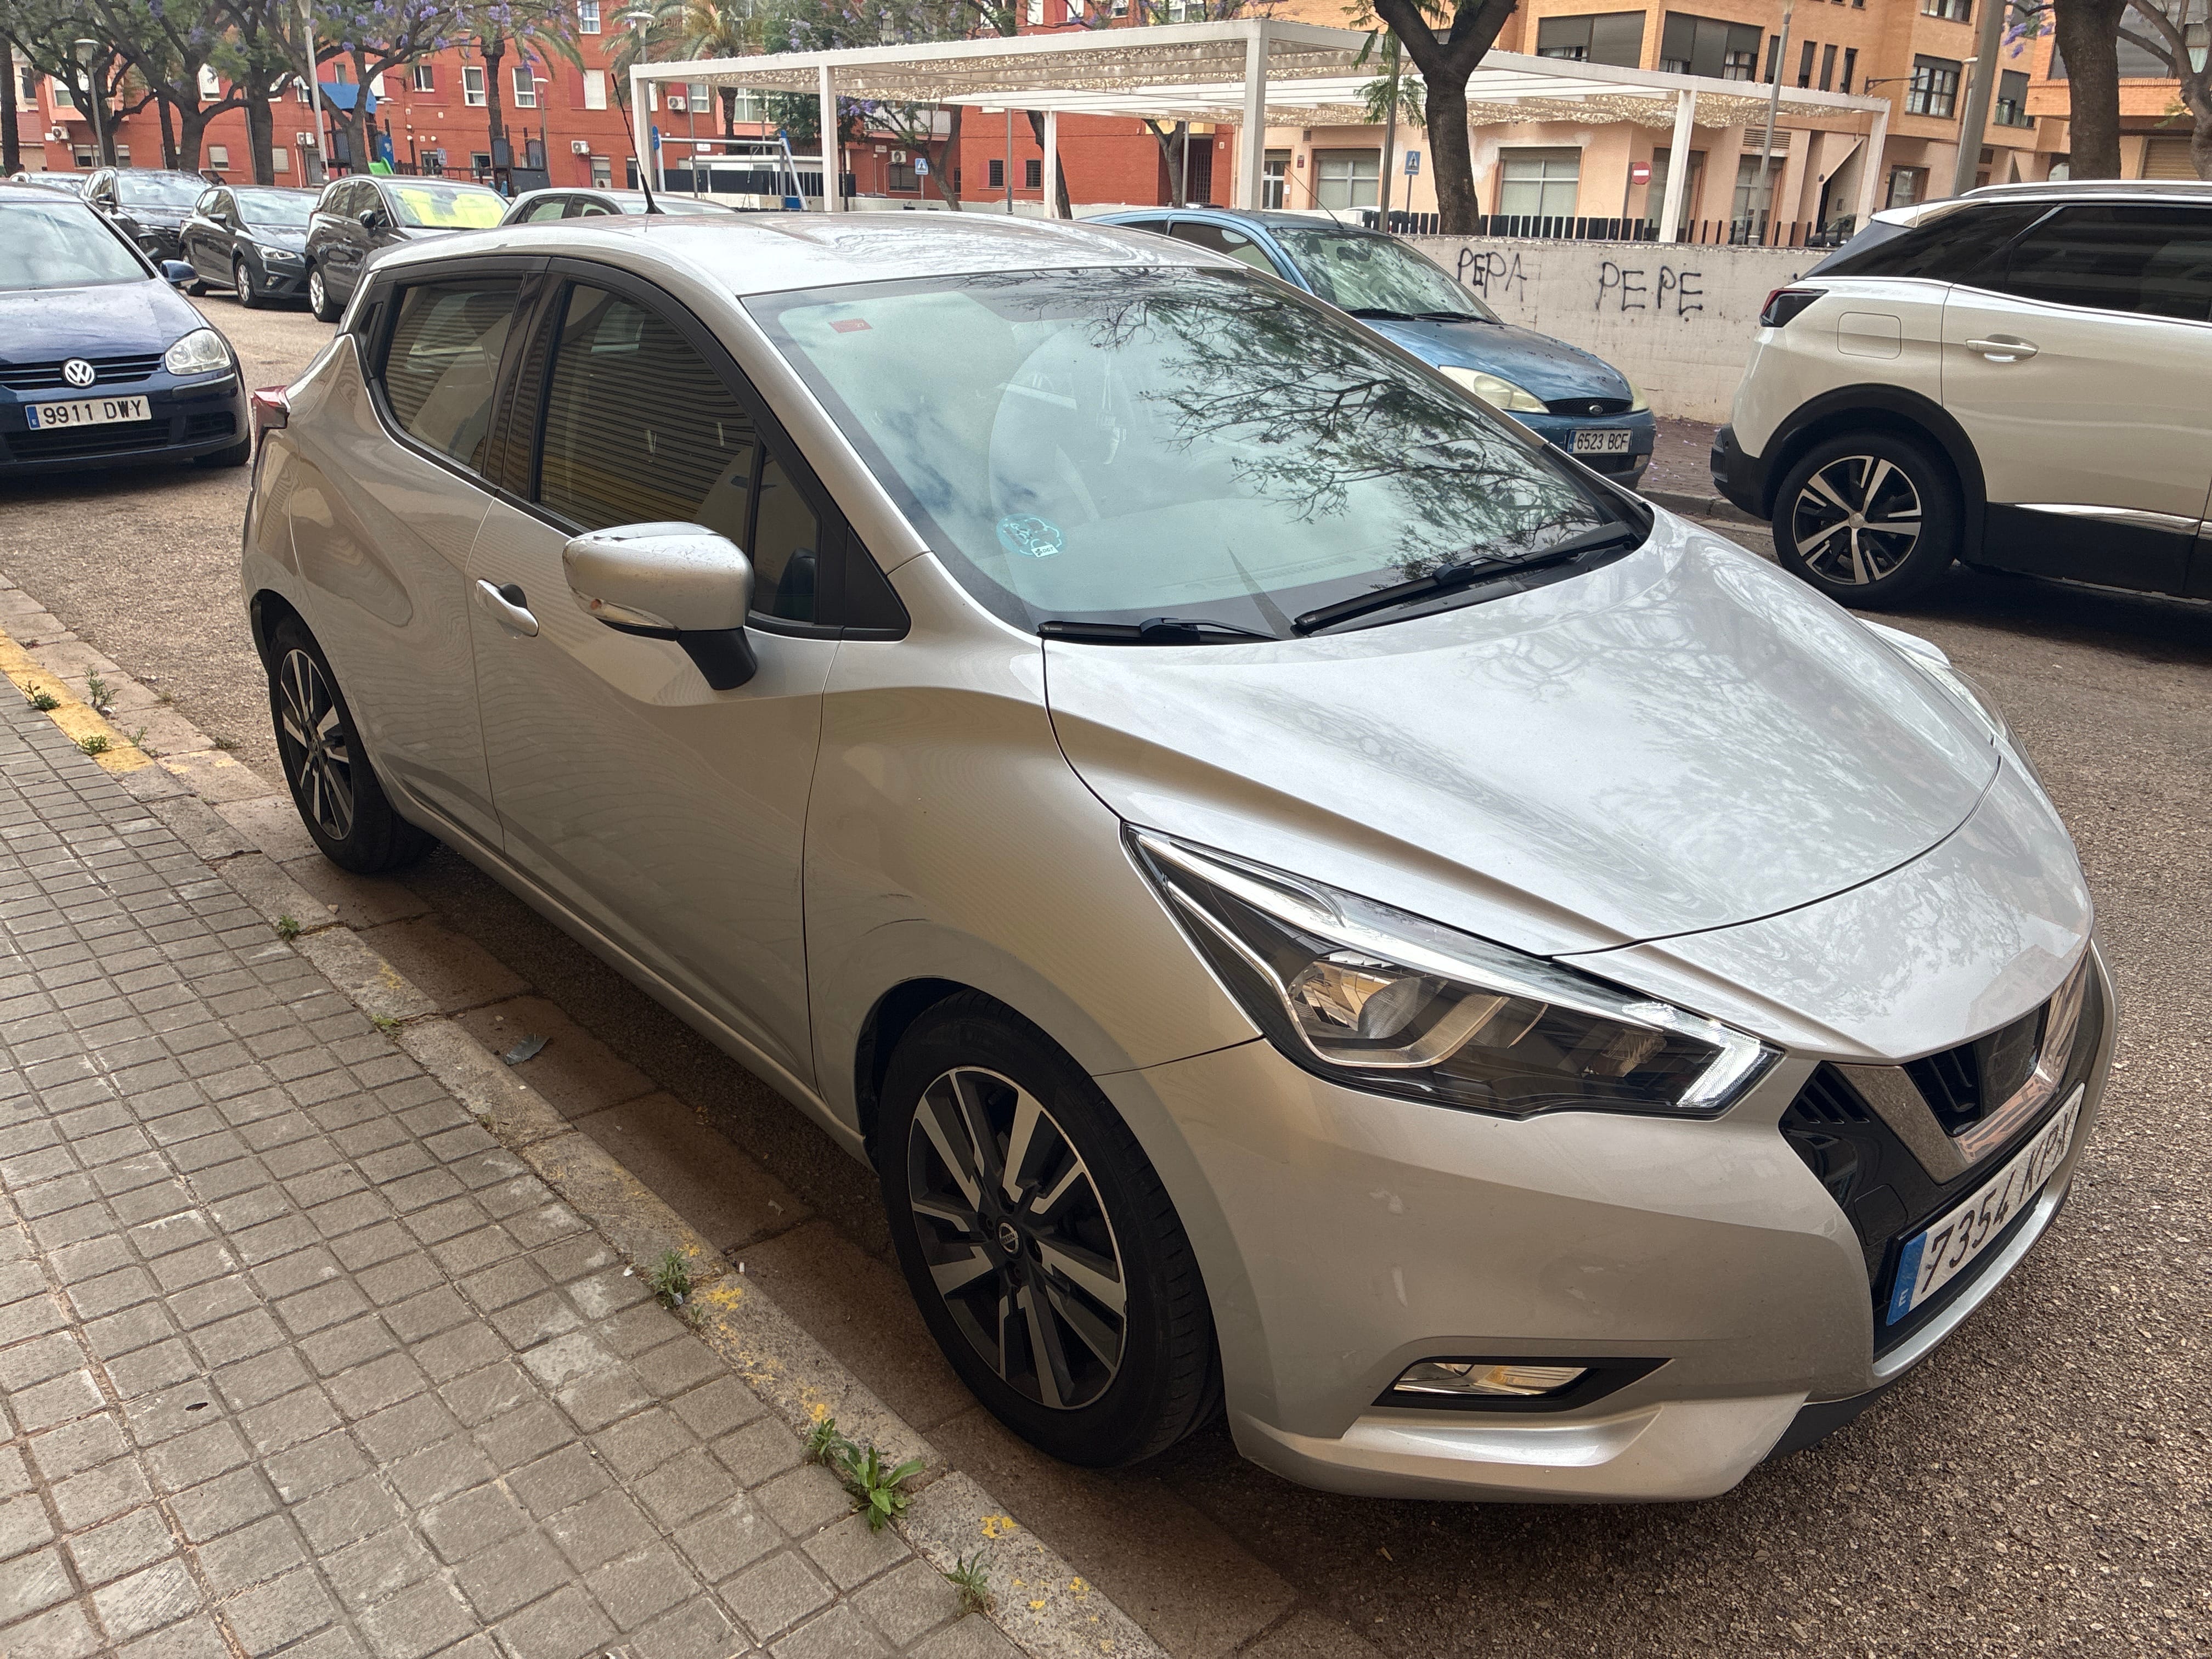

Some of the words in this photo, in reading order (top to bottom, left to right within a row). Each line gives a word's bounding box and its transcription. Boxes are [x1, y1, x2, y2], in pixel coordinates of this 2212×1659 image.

[1457, 247, 1528, 302] PEPA
[1595, 261, 1703, 315] PEPE
[43, 403, 93, 425] 9911
[103, 399, 142, 420] DWY
[1577, 433, 1604, 450] 6523
[1607, 433, 1629, 450] BCF
[1921, 1169, 2017, 1295] 7354
